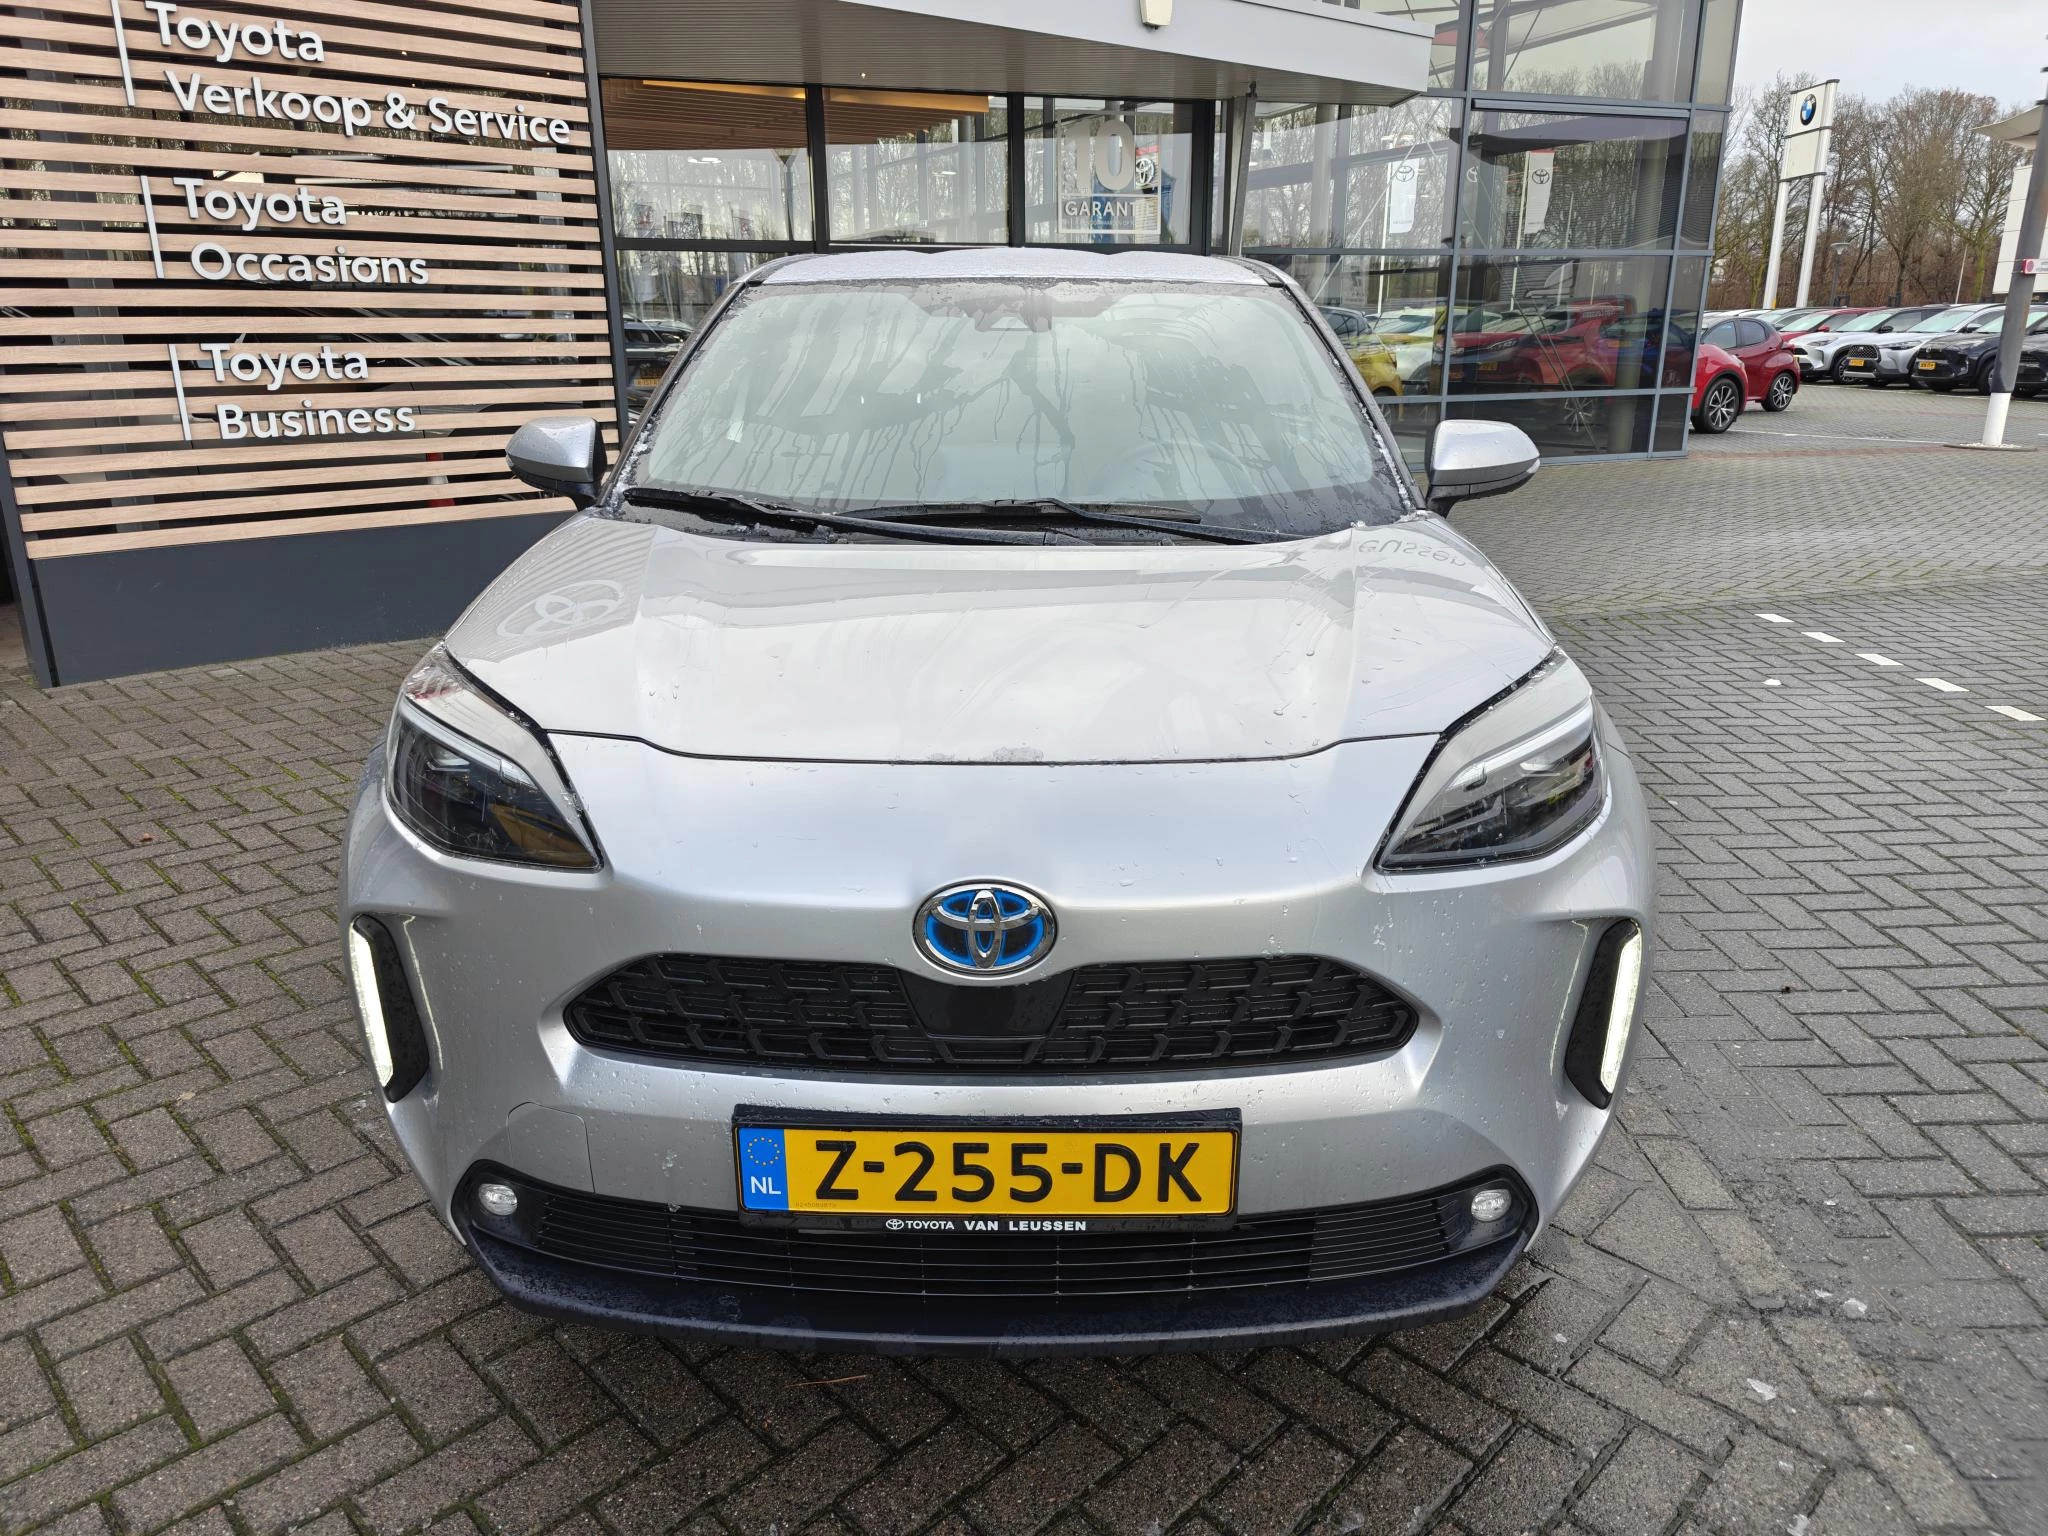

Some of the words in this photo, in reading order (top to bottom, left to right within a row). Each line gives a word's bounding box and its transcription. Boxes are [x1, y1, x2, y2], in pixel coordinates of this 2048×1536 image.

[145, 1, 325, 63] Toyota
[165, 70, 372, 137] Verkoop
[384, 91, 416, 131] &
[430, 96, 571, 144] Service
[1063, 118, 1135, 192] 10
[173, 176, 347, 231] Toyota
[1065, 200, 1155, 217] GARANT
[190, 242, 430, 285] Occasions
[200, 342, 369, 390] Toyota
[217, 400, 416, 441] Business
[750, 1175, 782, 1196] NL
[815, 1139, 1203, 1203] Z-255-DK
[905, 1219, 955, 1231] TOYOTA
[964, 1220, 1000, 1231] VAN
[1008, 1219, 1087, 1232] LEUSSEN
